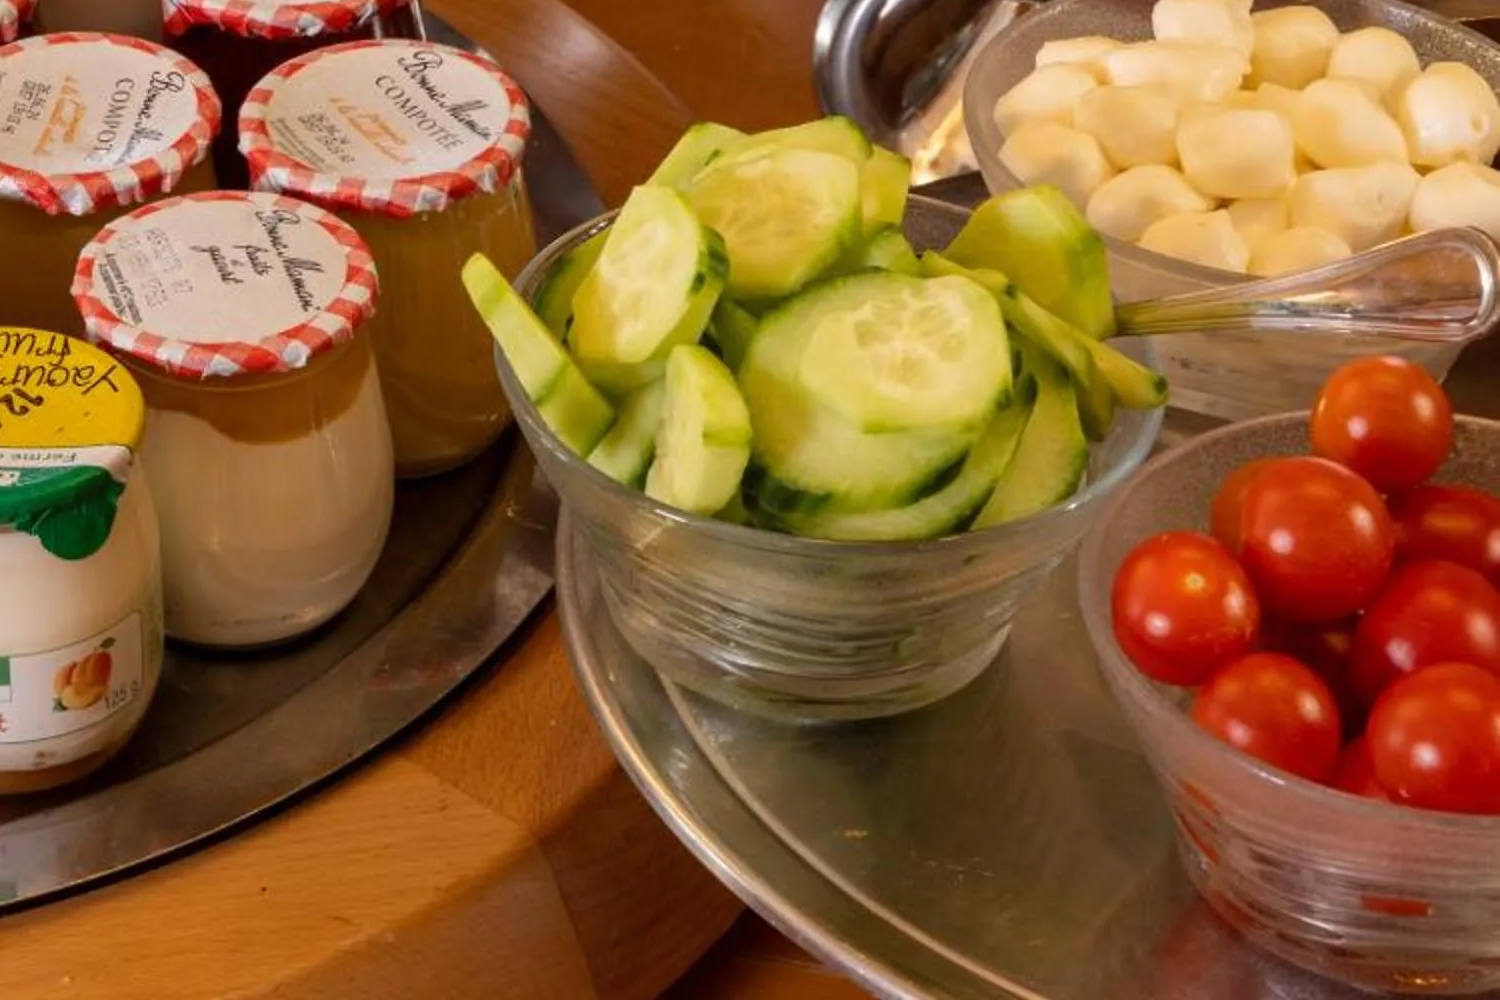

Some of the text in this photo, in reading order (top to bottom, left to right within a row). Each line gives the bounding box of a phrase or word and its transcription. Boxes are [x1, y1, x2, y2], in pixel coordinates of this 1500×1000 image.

[149, 70, 185, 119] Bonne
[398, 50, 446, 103] Bonne
[375, 75, 465, 150] COMPOTÉE
[10, 451, 78, 463] Ferme
